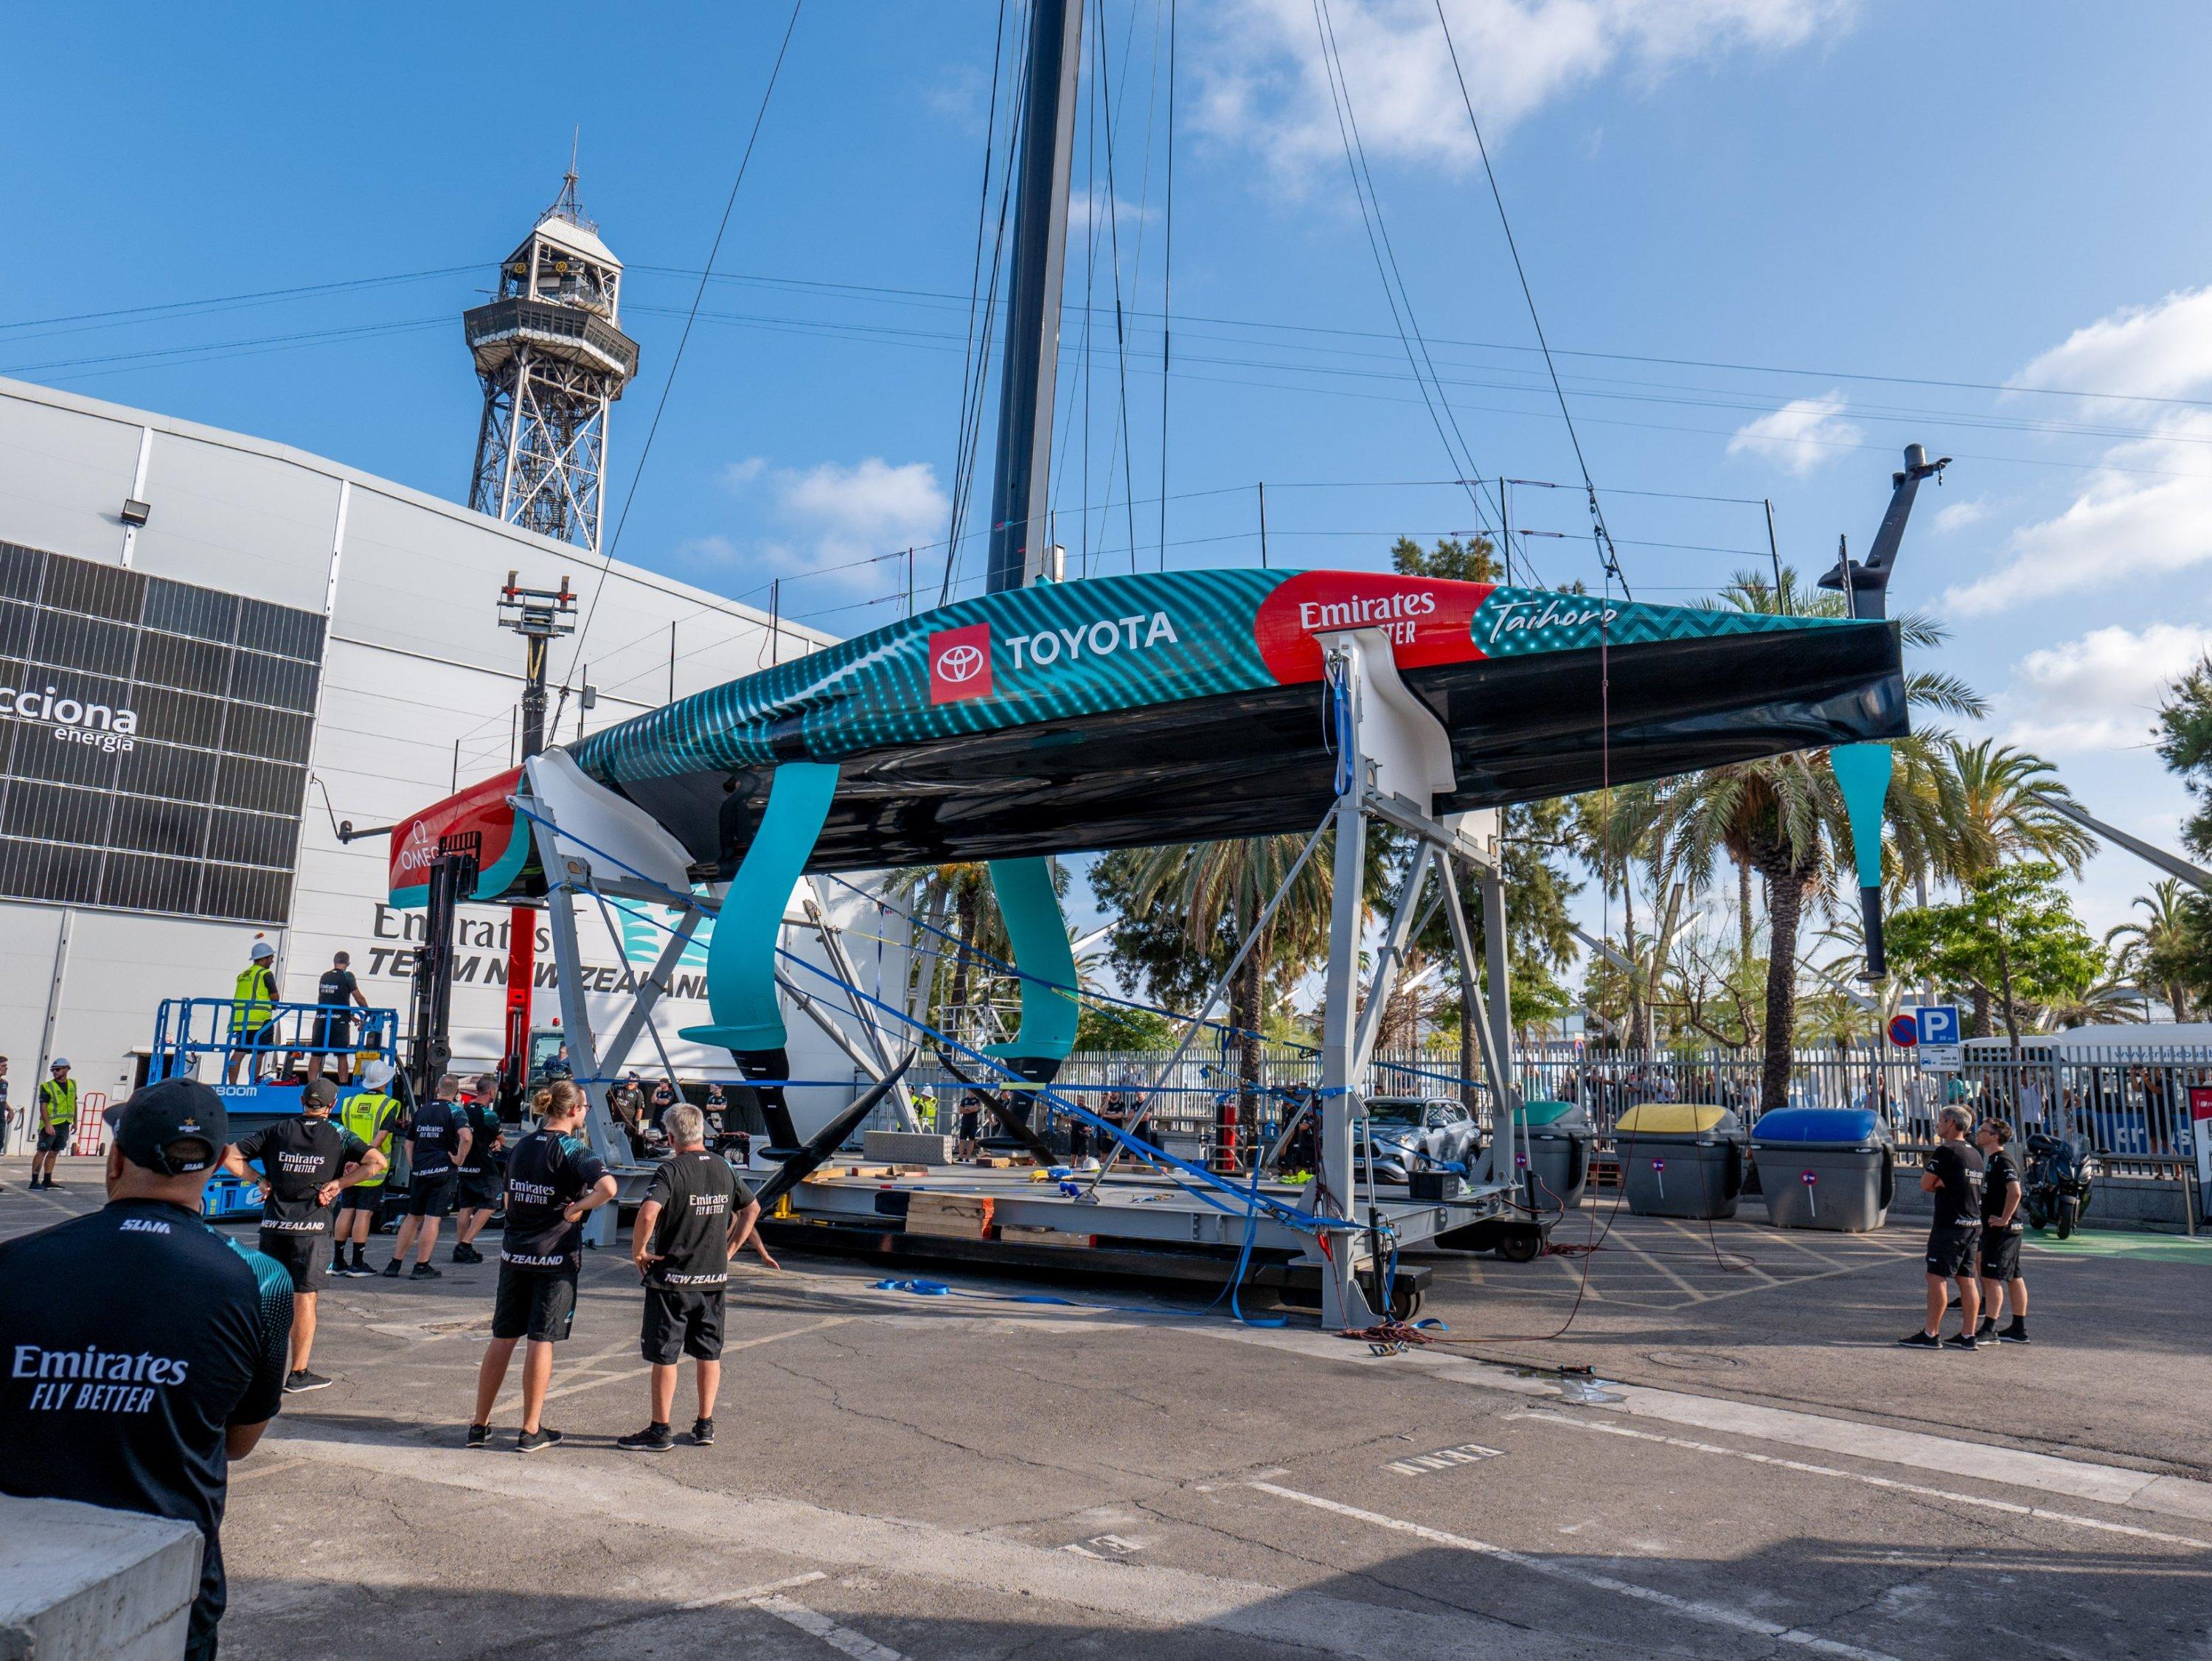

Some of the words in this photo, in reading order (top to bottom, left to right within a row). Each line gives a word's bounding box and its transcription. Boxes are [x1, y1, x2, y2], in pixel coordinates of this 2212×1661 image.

[1298, 592, 1436, 630] Emirates
[1489, 600, 1617, 644] Taihoro
[1005, 611, 1179, 669] TOYOTA
[369, 947, 481, 982] TEM
[483, 958, 558, 989] NW
[1924, 1011, 1950, 1041] P
[211, 1086, 257, 1097] BOOM
[279, 1152, 325, 1165] Emirates
[282, 1163, 293, 1171] FLY
[293, 1164, 316, 1173] BETTER
[419, 1166, 448, 1176] ZEALAND
[510, 1179, 555, 1194] Emirates
[515, 1192, 525, 1202] FLY
[525, 1193, 547, 1205] BETTER
[689, 1194, 728, 1206] Emirates
[696, 1206, 705, 1216] FLY
[706, 1205, 724, 1215] BETTER
[119, 1219, 170, 1234] SLAM
[260, 1219, 279, 1228] NEW
[278, 1222, 324, 1230] ZEALAND
[510, 1254, 563, 1266] ZEALAND
[664, 1272, 692, 1284] NEW
[12, 1344, 189, 1386] Emirates
[29, 1383, 73, 1410] FLY
[74, 1383, 156, 1413] BETTER
